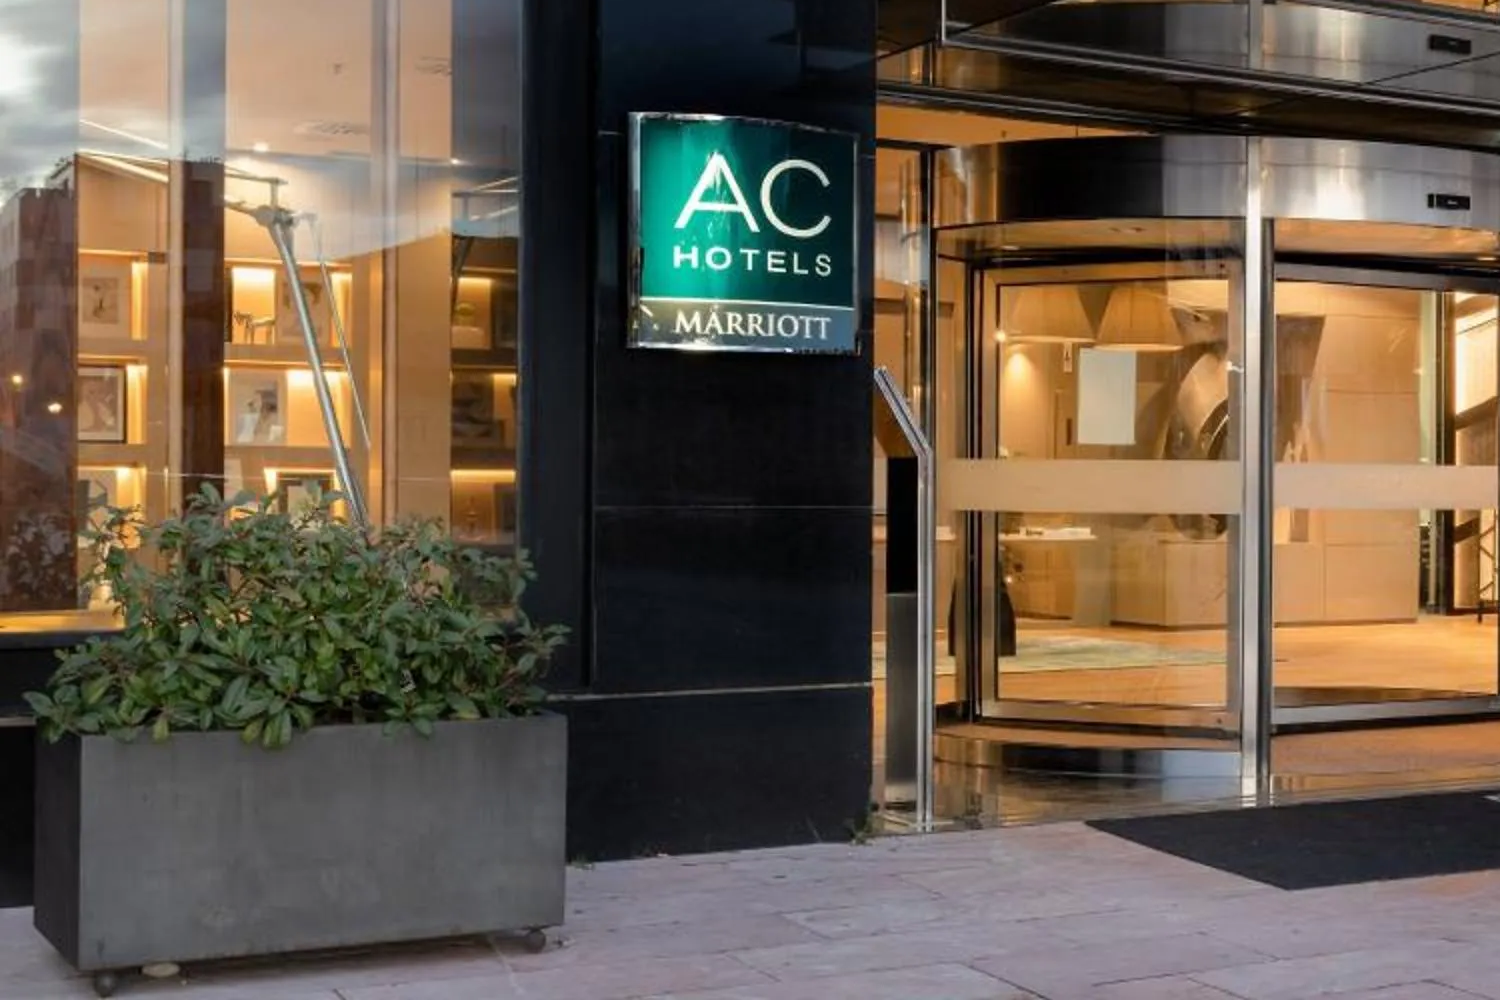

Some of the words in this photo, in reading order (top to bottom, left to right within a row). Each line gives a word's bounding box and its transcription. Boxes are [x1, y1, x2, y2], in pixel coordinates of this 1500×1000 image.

[673, 149, 833, 239] AC
[672, 245, 833, 278] HOTELS
[673, 309, 832, 340] MARRIOTT
